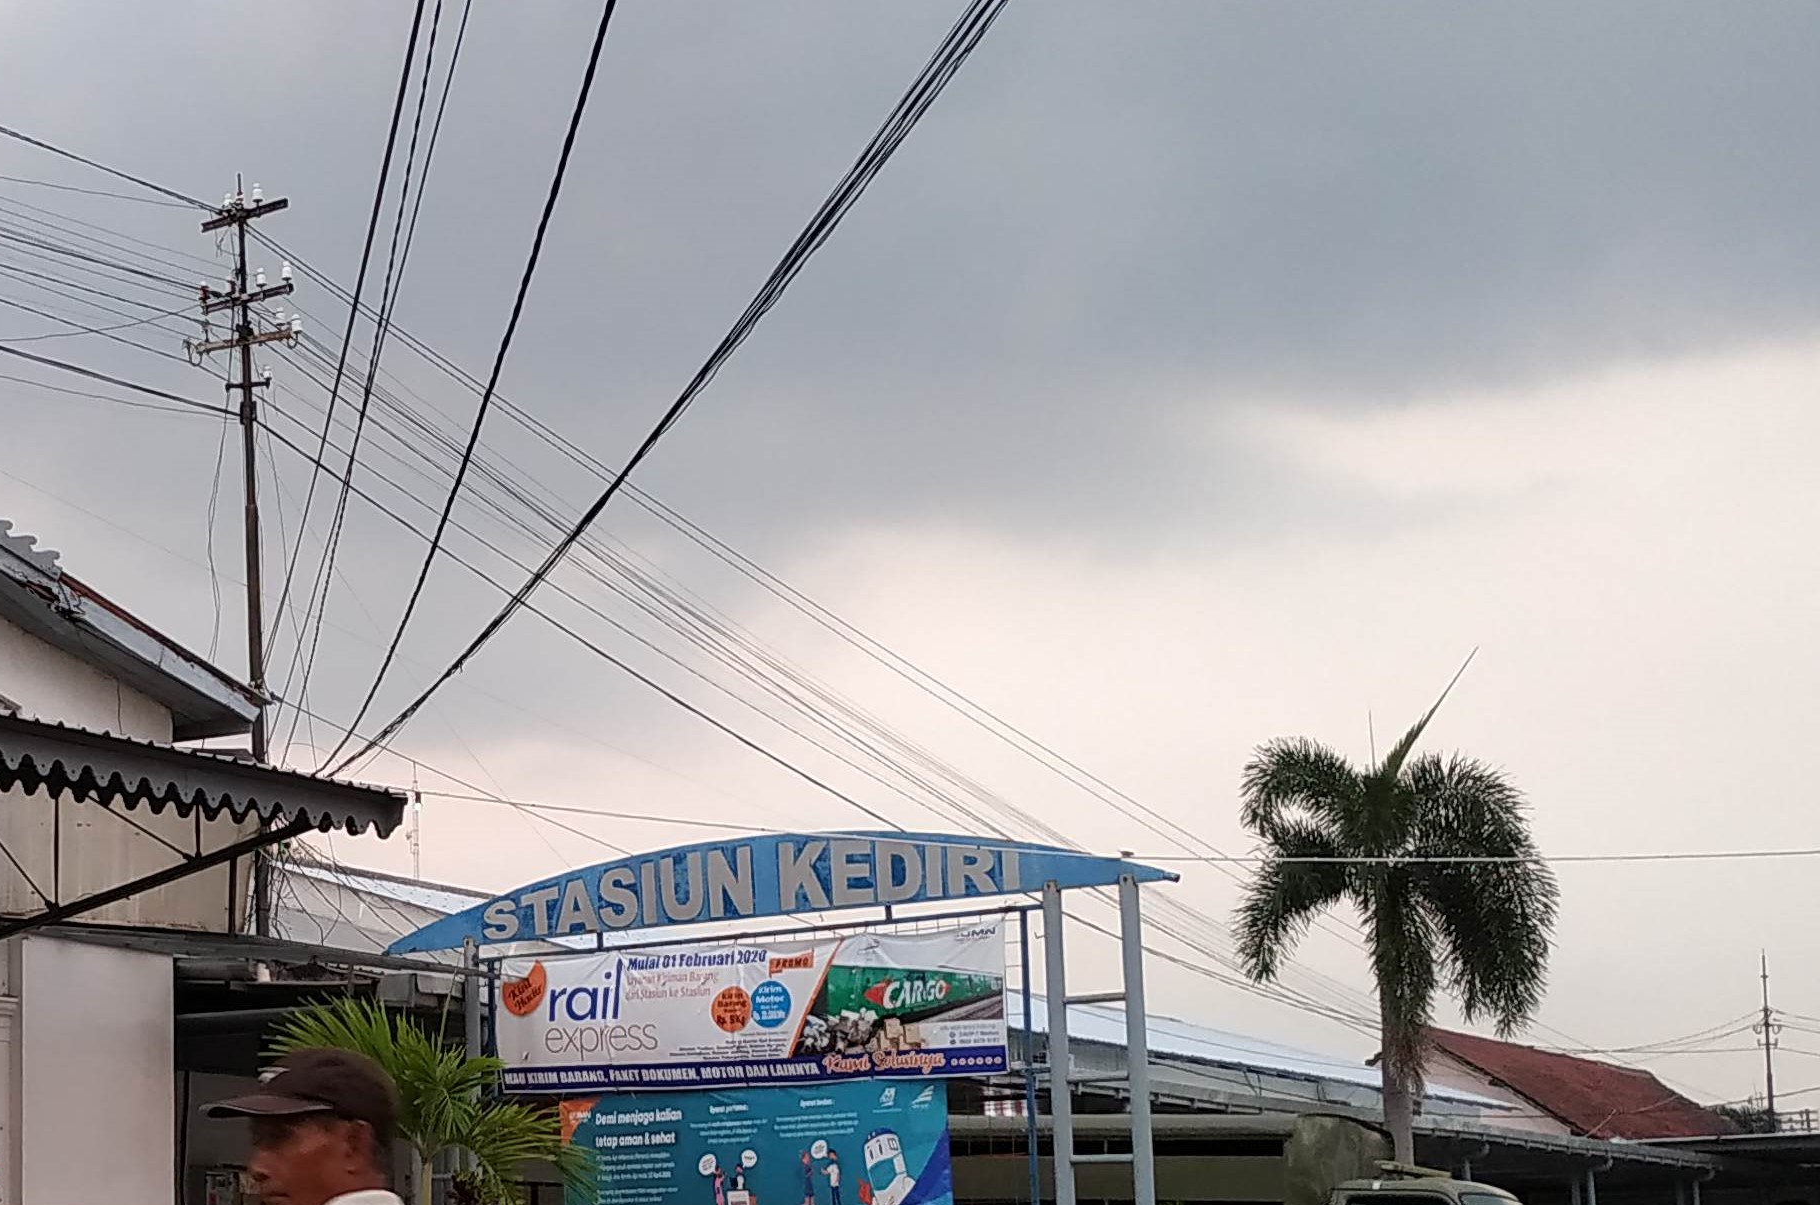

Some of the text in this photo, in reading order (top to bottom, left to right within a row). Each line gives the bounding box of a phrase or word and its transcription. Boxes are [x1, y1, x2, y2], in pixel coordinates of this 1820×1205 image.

[482, 839, 1022, 940] STASIUN KEDIRI
[678, 952, 734, 968] Februari
[736, 949, 768, 965] 2020
[549, 958, 623, 1022] rail
[882, 979, 948, 1010] CARGO
[545, 1023, 658, 1061] express
[526, 1071, 559, 1084] KIRIM
[641, 1067, 700, 1081] DOKUMEN,
[700, 1066, 745, 1080] MOTOR
[745, 1064, 769, 1078] DAN
[770, 1062, 820, 1077] LAINNYA
[822, 1053, 871, 1074] Kami
[595, 1107, 682, 1126] Demi menjaga kalian
[619, 1135, 643, 1146] aman
[644, 1132, 650, 1145] &
[651, 1131, 676, 1145] sehat
